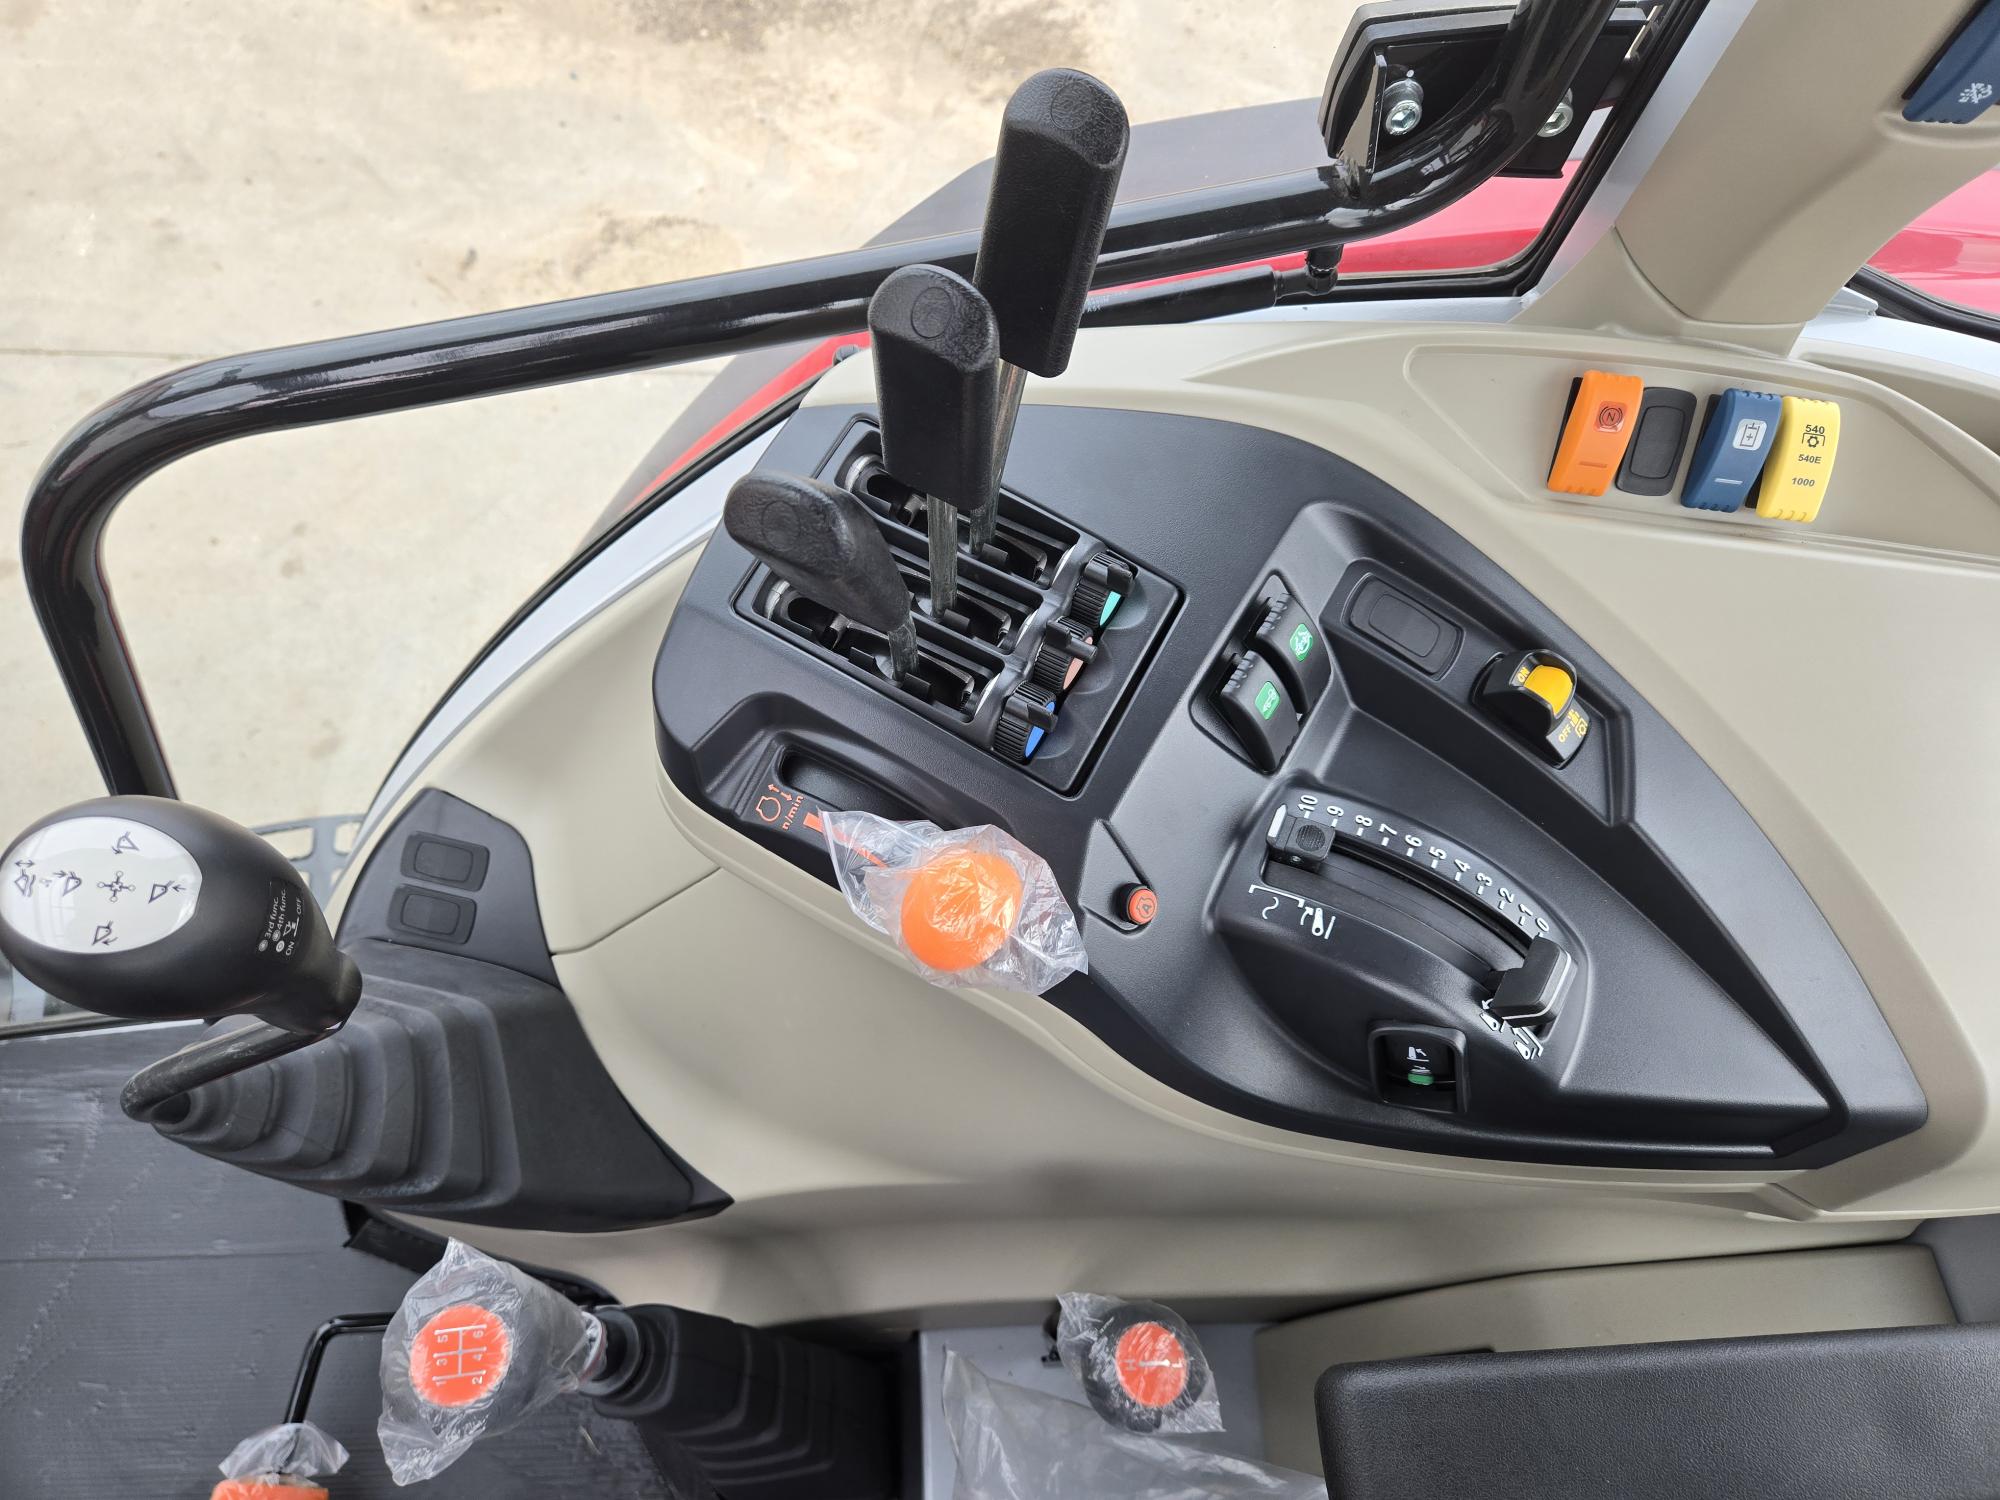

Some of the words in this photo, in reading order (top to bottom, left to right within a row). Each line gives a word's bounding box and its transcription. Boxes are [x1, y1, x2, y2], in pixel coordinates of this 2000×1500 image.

[1607, 412, 1616, 422] N
[1805, 424, 1826, 435] 540
[1798, 453, 1822, 465] 540E
[1791, 477, 1815, 487] 1000
[1516, 666, 1531, 683] ON
[1558, 723, 1572, 743] OFF
[1297, 794, 1318, 812] 10
[782, 795, 804, 830] n/min
[1326, 805, 1344, 817] 9
[1355, 814, 1373, 827] 8
[1378, 823, 1398, 836] 7
[1405, 834, 1422, 847] 6
[1429, 846, 1447, 859] 5
[1454, 858, 1471, 872] 4
[1477, 872, 1493, 887] 3
[1499, 887, 1514, 903] 2
[1142, 903, 1152, 915] A
[1519, 903, 1533, 916] 1
[277, 914, 285, 930] 4th
[1536, 917, 1549, 932] 0
[264, 921, 275, 939] 3rd
[285, 941, 295, 956] ON
[437, 1334, 448, 1343] 5
[472, 1330, 484, 1339] 6
[436, 1358, 448, 1366] 3
[472, 1353, 483, 1361] 4
[471, 1376, 483, 1385] 2
